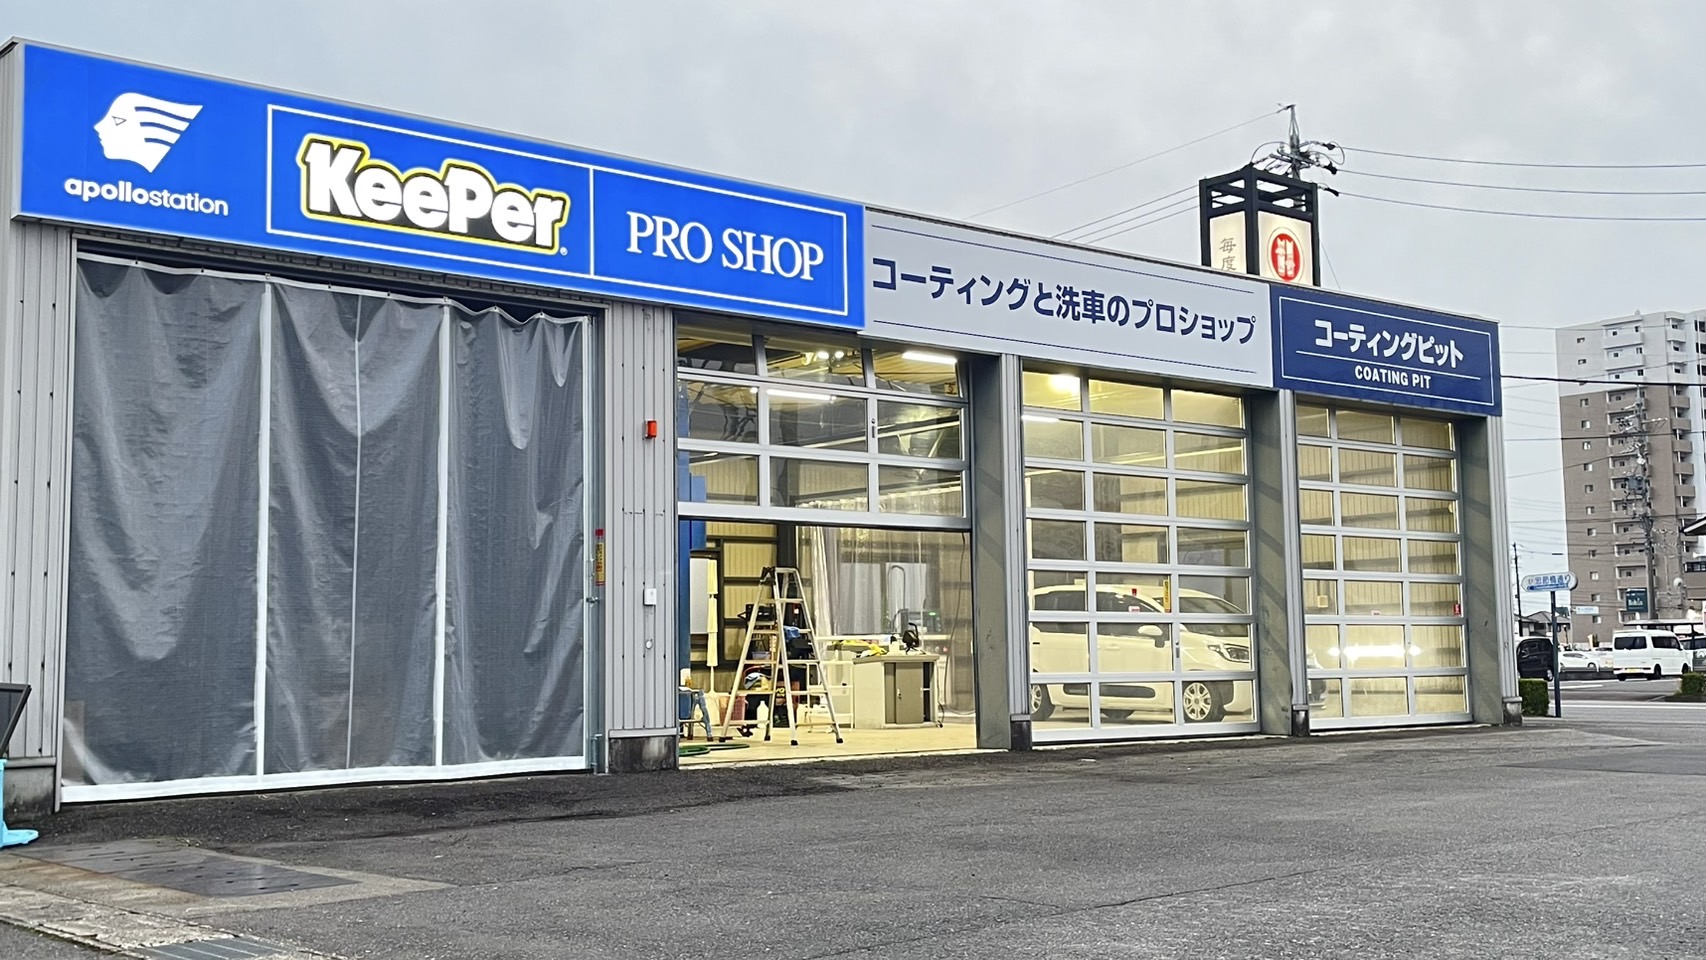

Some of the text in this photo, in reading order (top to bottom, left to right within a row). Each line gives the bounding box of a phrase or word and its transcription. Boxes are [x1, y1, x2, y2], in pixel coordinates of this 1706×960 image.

[64, 178, 228, 216] apollostation
[301, 138, 566, 250] KeePer
[626, 211, 824, 281] PRO SHOP
[872, 257, 1256, 345] コーティングと洗車のプロショップ
[1314, 319, 1464, 369] コーティングピット
[1354, 364, 1432, 389] COATING PIT
